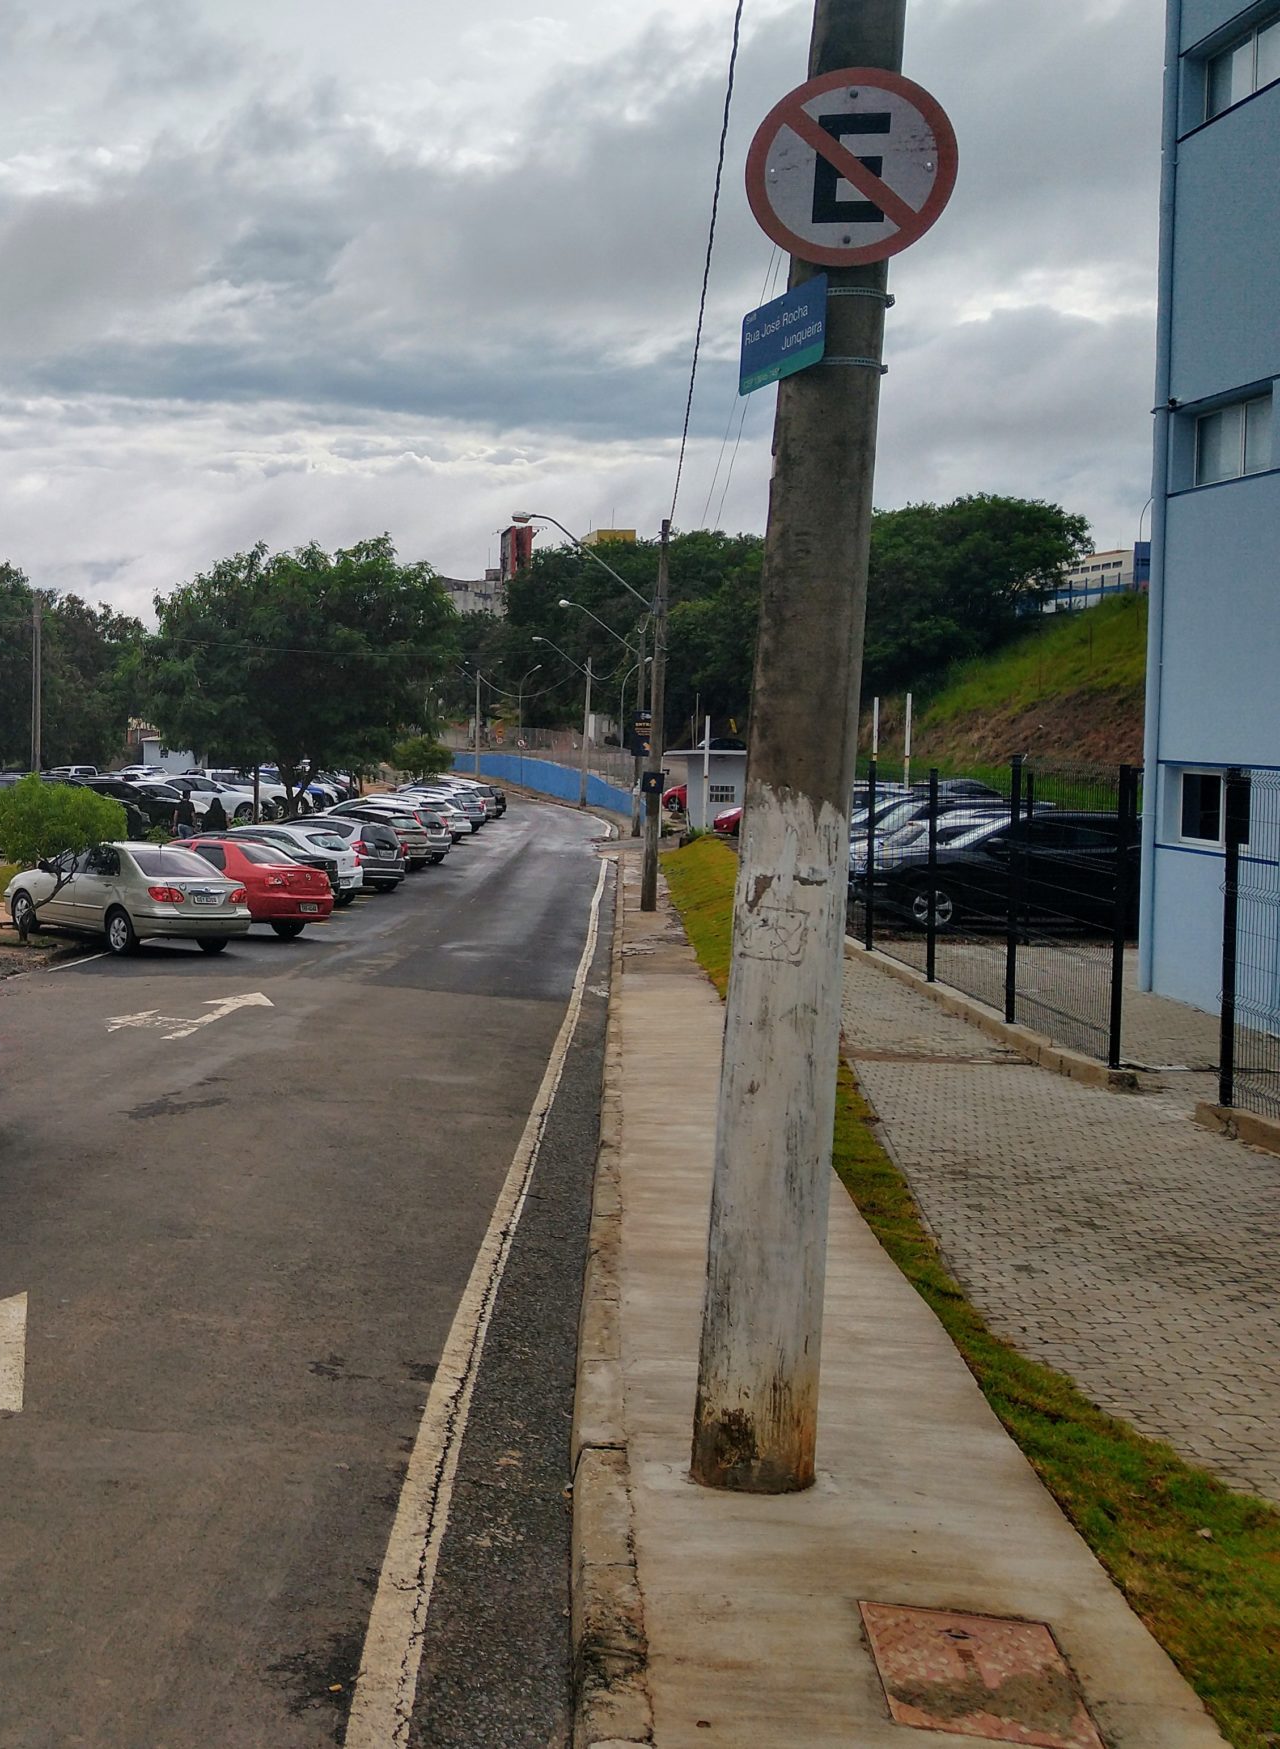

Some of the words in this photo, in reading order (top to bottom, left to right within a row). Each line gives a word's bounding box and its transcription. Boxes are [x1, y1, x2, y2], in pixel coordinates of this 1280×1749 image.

[812, 112, 891, 224] E
[744, 332, 760, 346] Rua
[761, 316, 781, 338] José
[782, 304, 809, 328] Rocha
[781, 320, 823, 351] Junqueira
